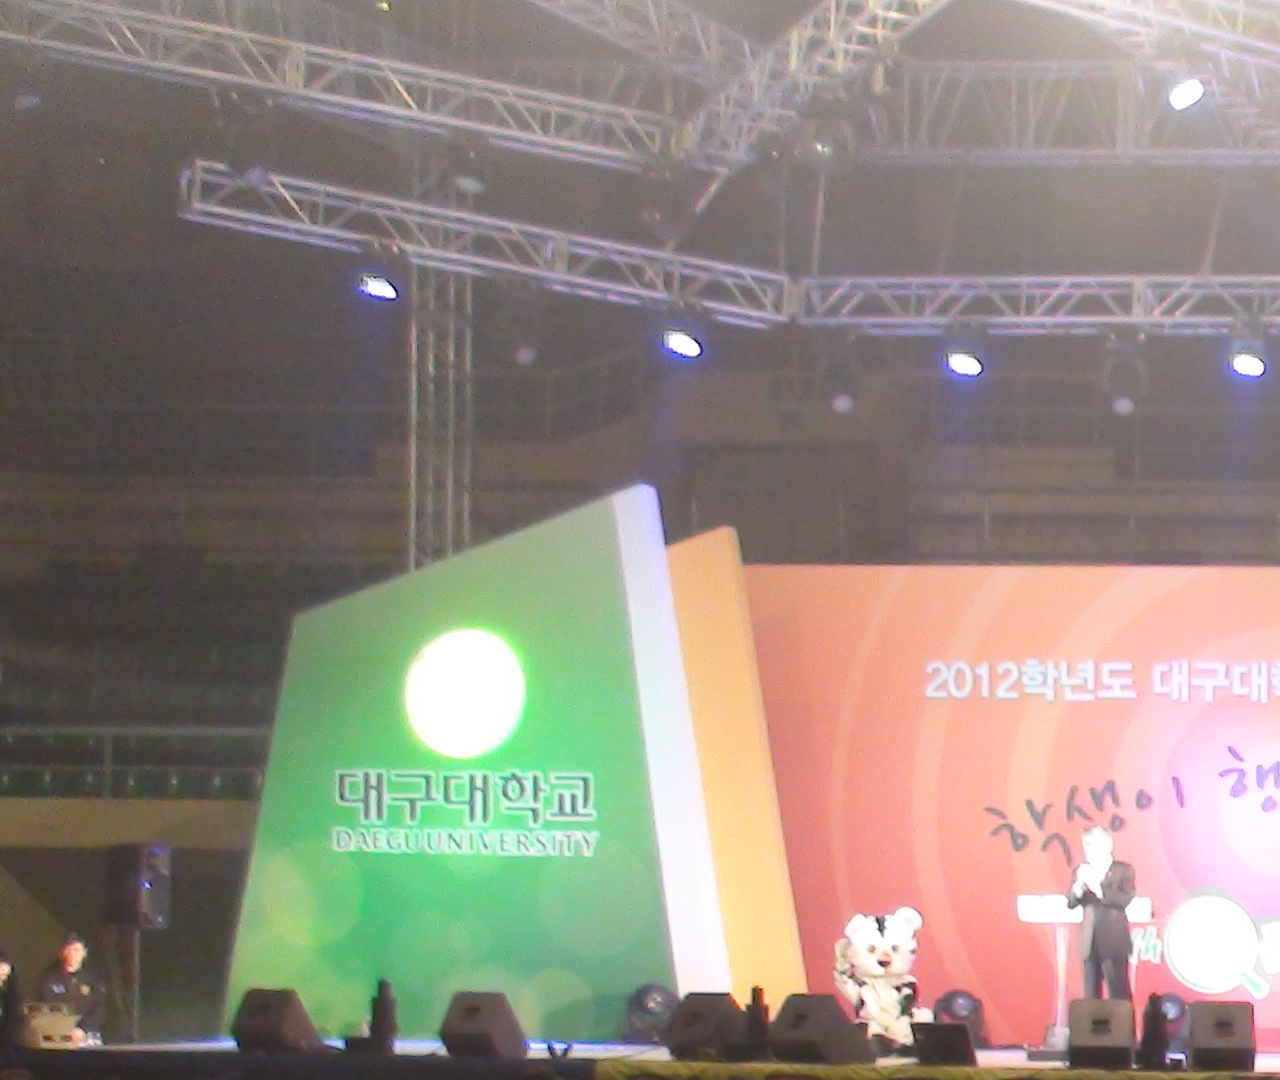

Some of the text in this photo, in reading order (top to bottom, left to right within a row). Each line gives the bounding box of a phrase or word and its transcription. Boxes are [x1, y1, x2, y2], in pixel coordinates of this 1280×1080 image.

[924, 659, 1138, 703] 2012학년도
[335, 768, 596, 827] 대구대학교
[982, 776, 1185, 868] 학생이
[332, 827, 599, 857] DAEGU UNIVERSITY
